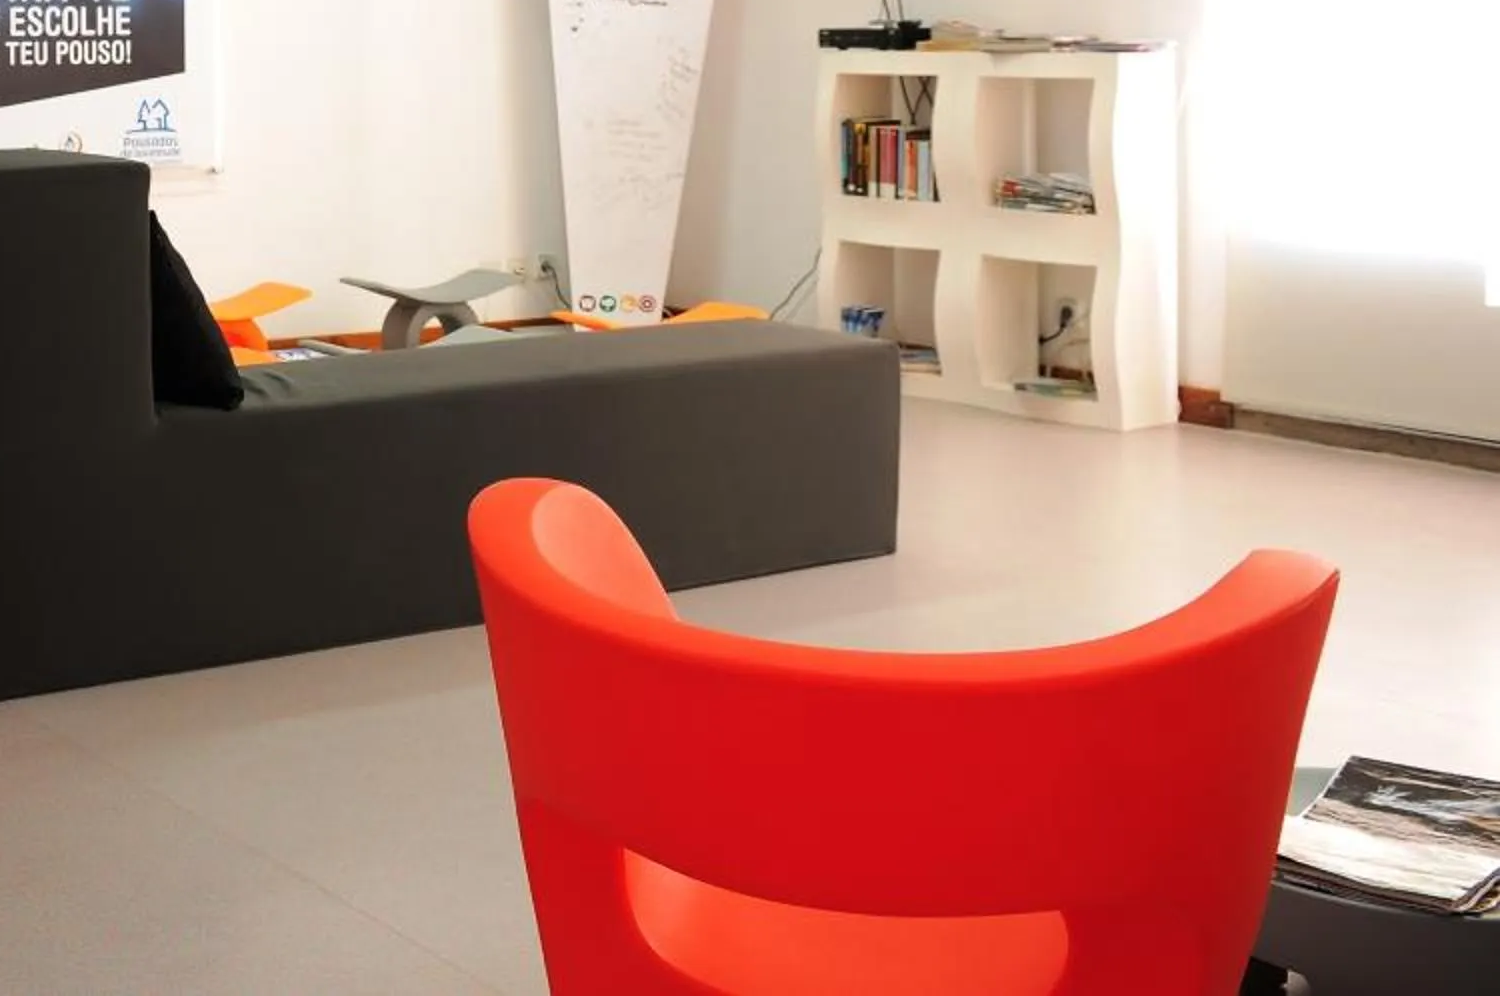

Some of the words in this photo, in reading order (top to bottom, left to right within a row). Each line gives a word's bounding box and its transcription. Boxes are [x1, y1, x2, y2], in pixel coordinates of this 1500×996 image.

[9, 6, 132, 37] ESCOLHE
[5, 40, 49, 67] TEU
[55, 39, 132, 66] POUSO!
